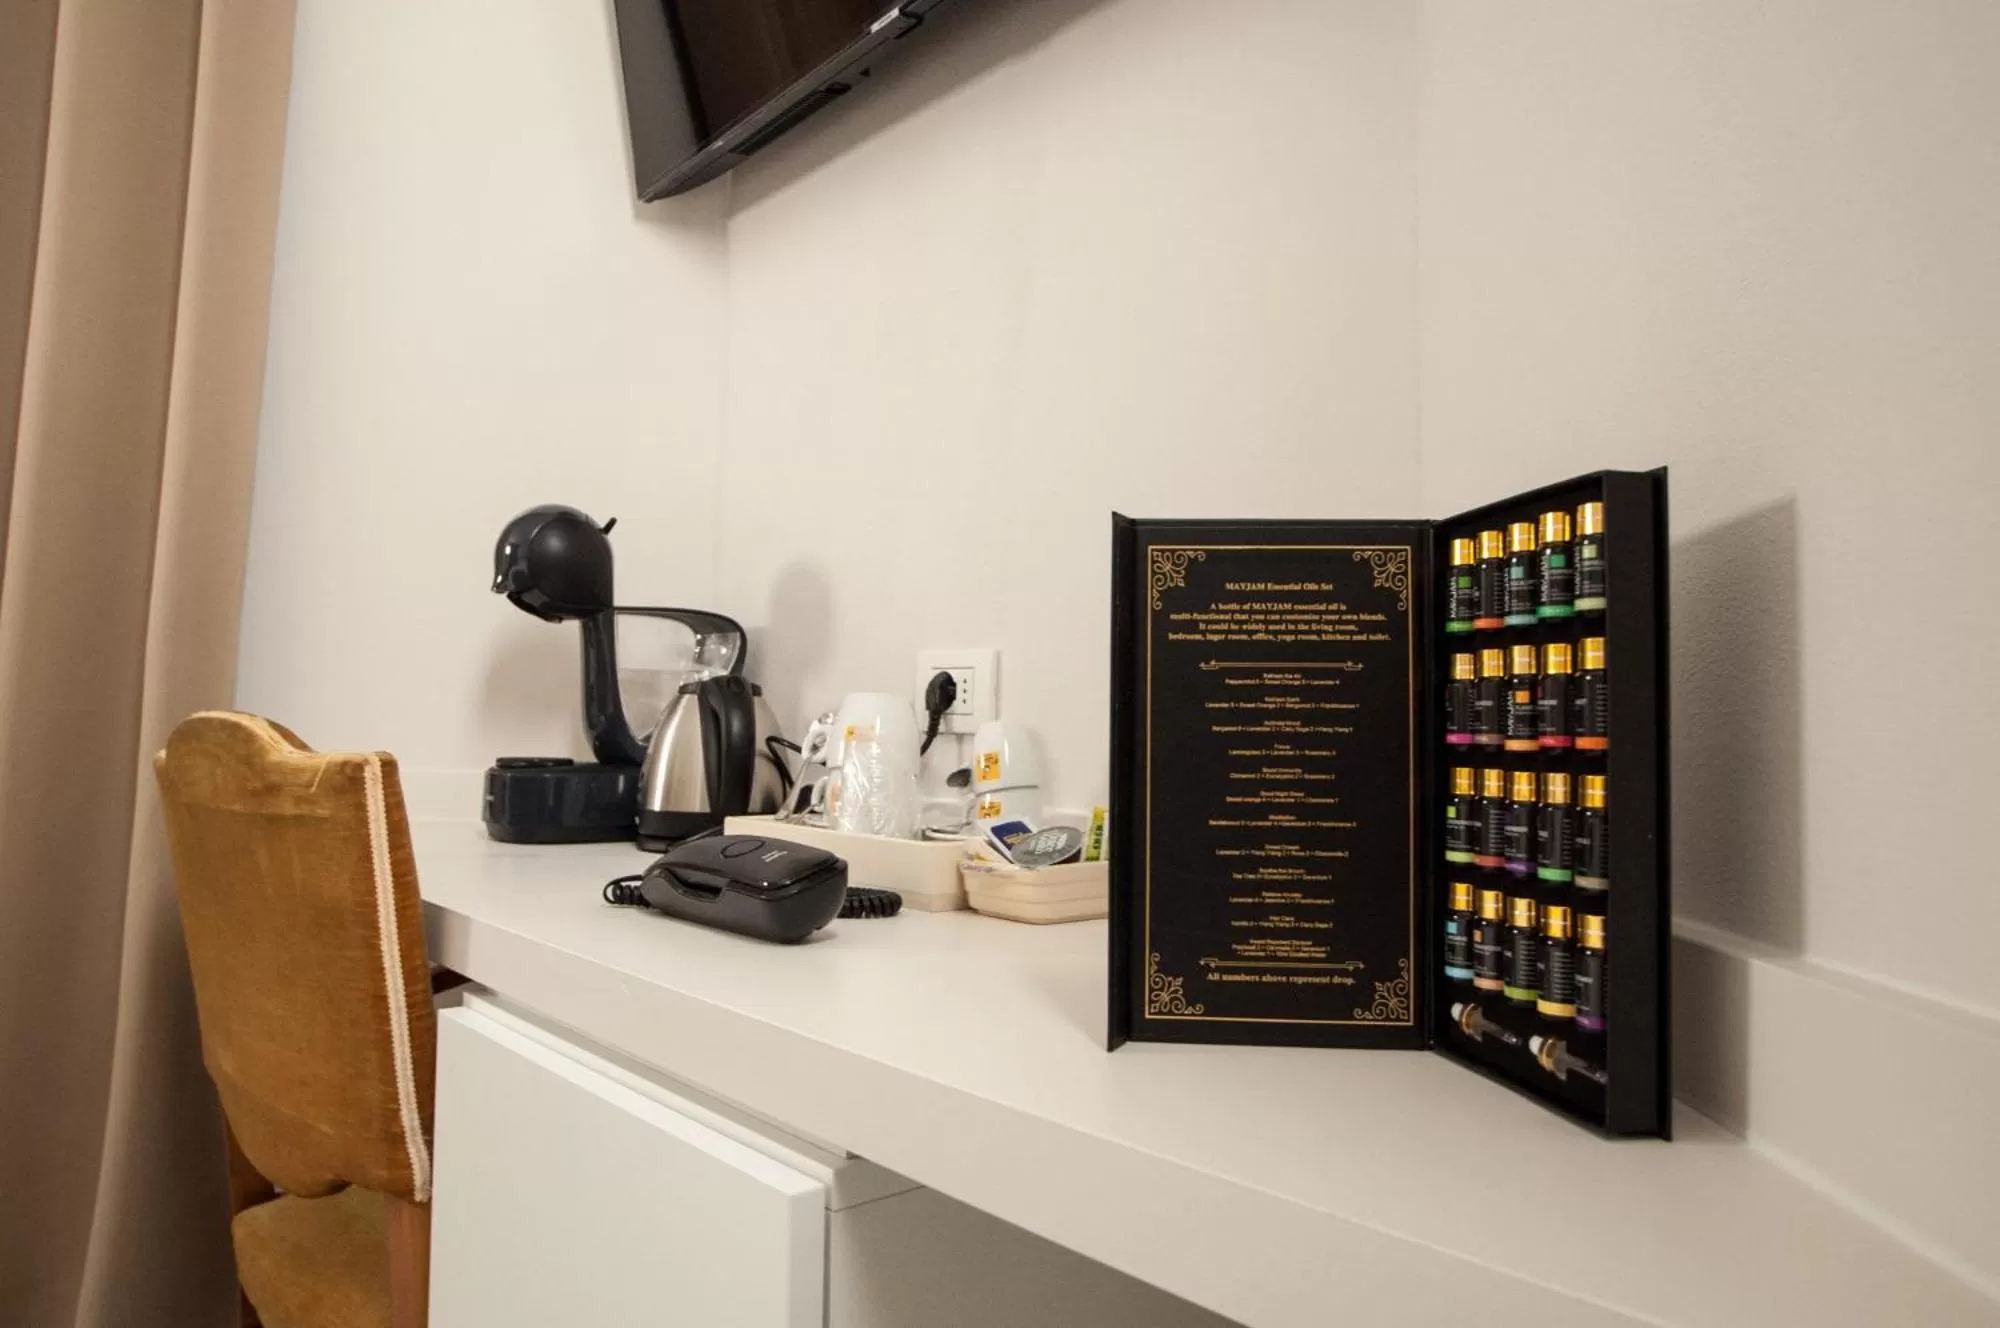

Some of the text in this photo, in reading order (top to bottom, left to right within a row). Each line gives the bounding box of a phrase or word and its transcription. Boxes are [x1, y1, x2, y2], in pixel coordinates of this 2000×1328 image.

[1225, 582, 1333, 591] MAYJAM Essential Oils Set
[1210, 602, 1347, 611] A bottle of MAYJAM essential oil is
[1233, 612, 1249, 621] that
[1250, 613, 1265, 623] you
[1266, 612, 1280, 621] can
[1321, 613, 1340, 623] your
[1341, 612, 1358, 621] own
[1199, 623, 1206, 631] It
[1207, 623, 1229, 631] could
[1230, 623, 1239, 631] be
[1242, 623, 1266, 633] widely
[1267, 623, 1286, 631] used
[1287, 623, 1295, 631] in
[1297, 623, 1310, 631] the
[1311, 623, 1333, 633] living
[1322, 633, 1351, 642] kitchen
[1352, 633, 1368, 642] and
[1207, 973, 1220, 982] All
[1222, 973, 1260, 982] numbers
[1262, 973, 1287, 982] above
[1289, 975, 1330, 985] represent
